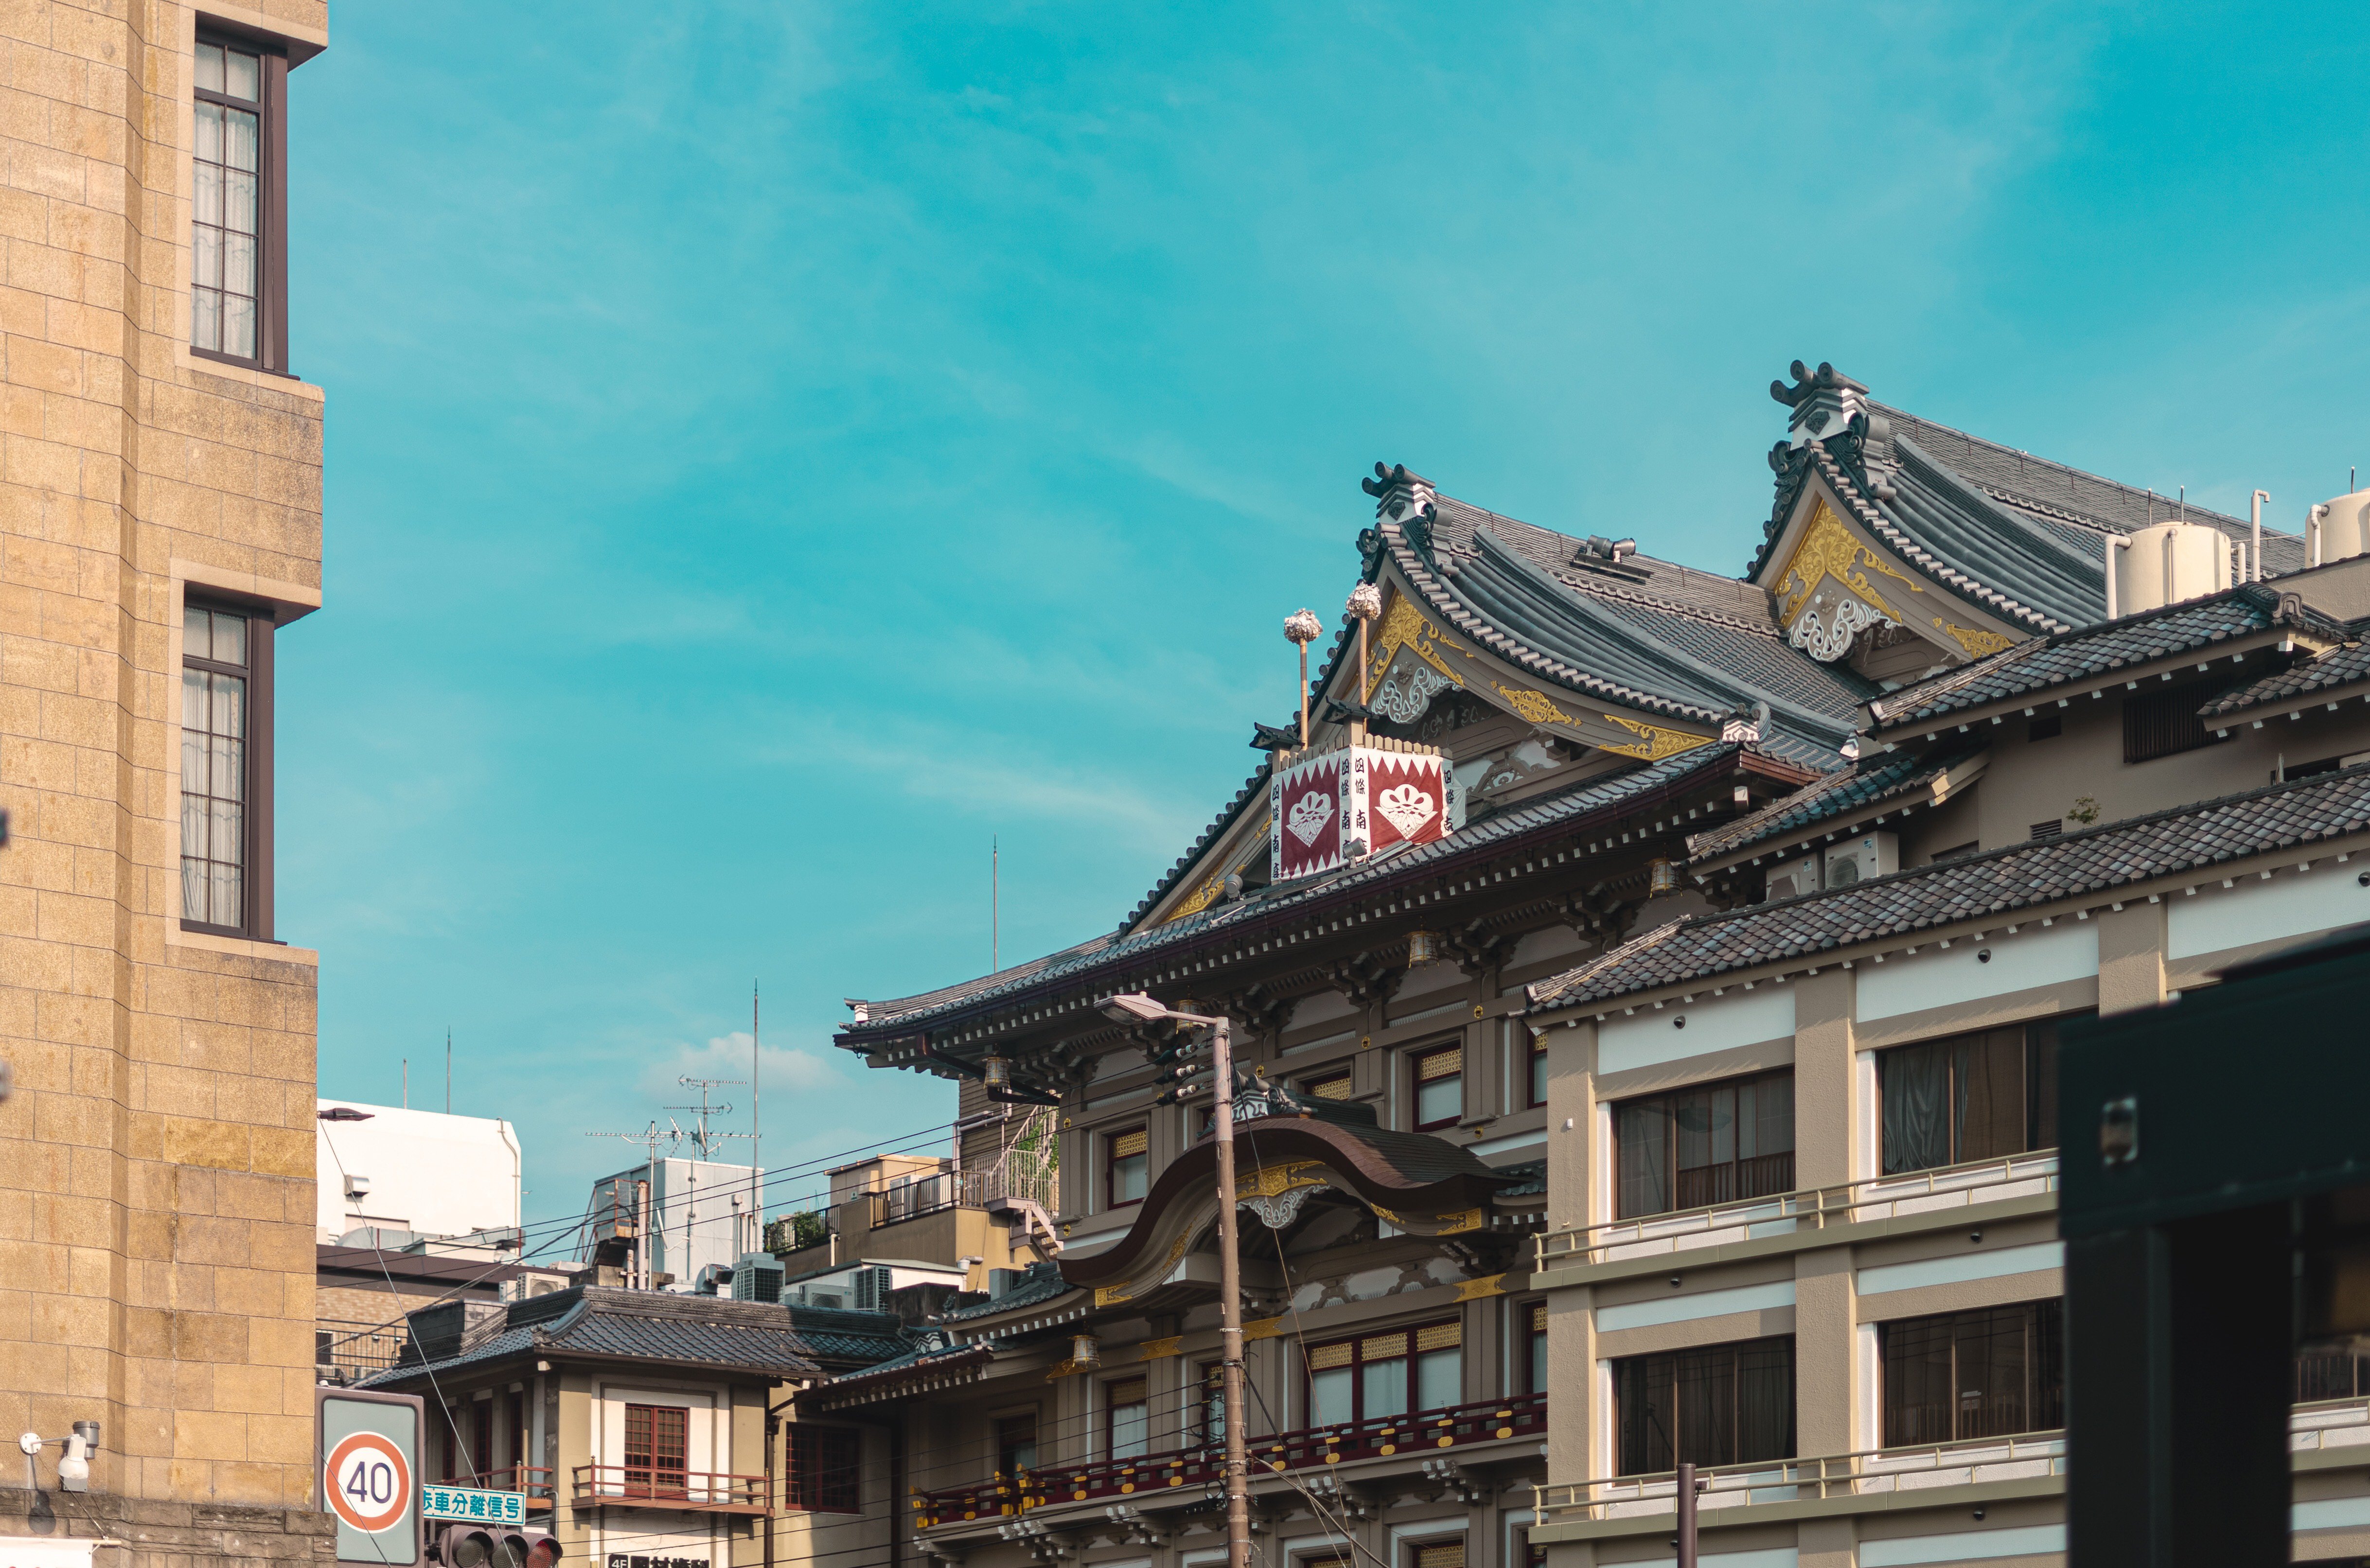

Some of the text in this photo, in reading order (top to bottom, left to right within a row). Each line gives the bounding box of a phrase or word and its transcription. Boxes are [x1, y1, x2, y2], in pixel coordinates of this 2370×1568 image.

[1355, 757, 1367, 847] 四條南
[347, 1462, 391, 1503] 40
